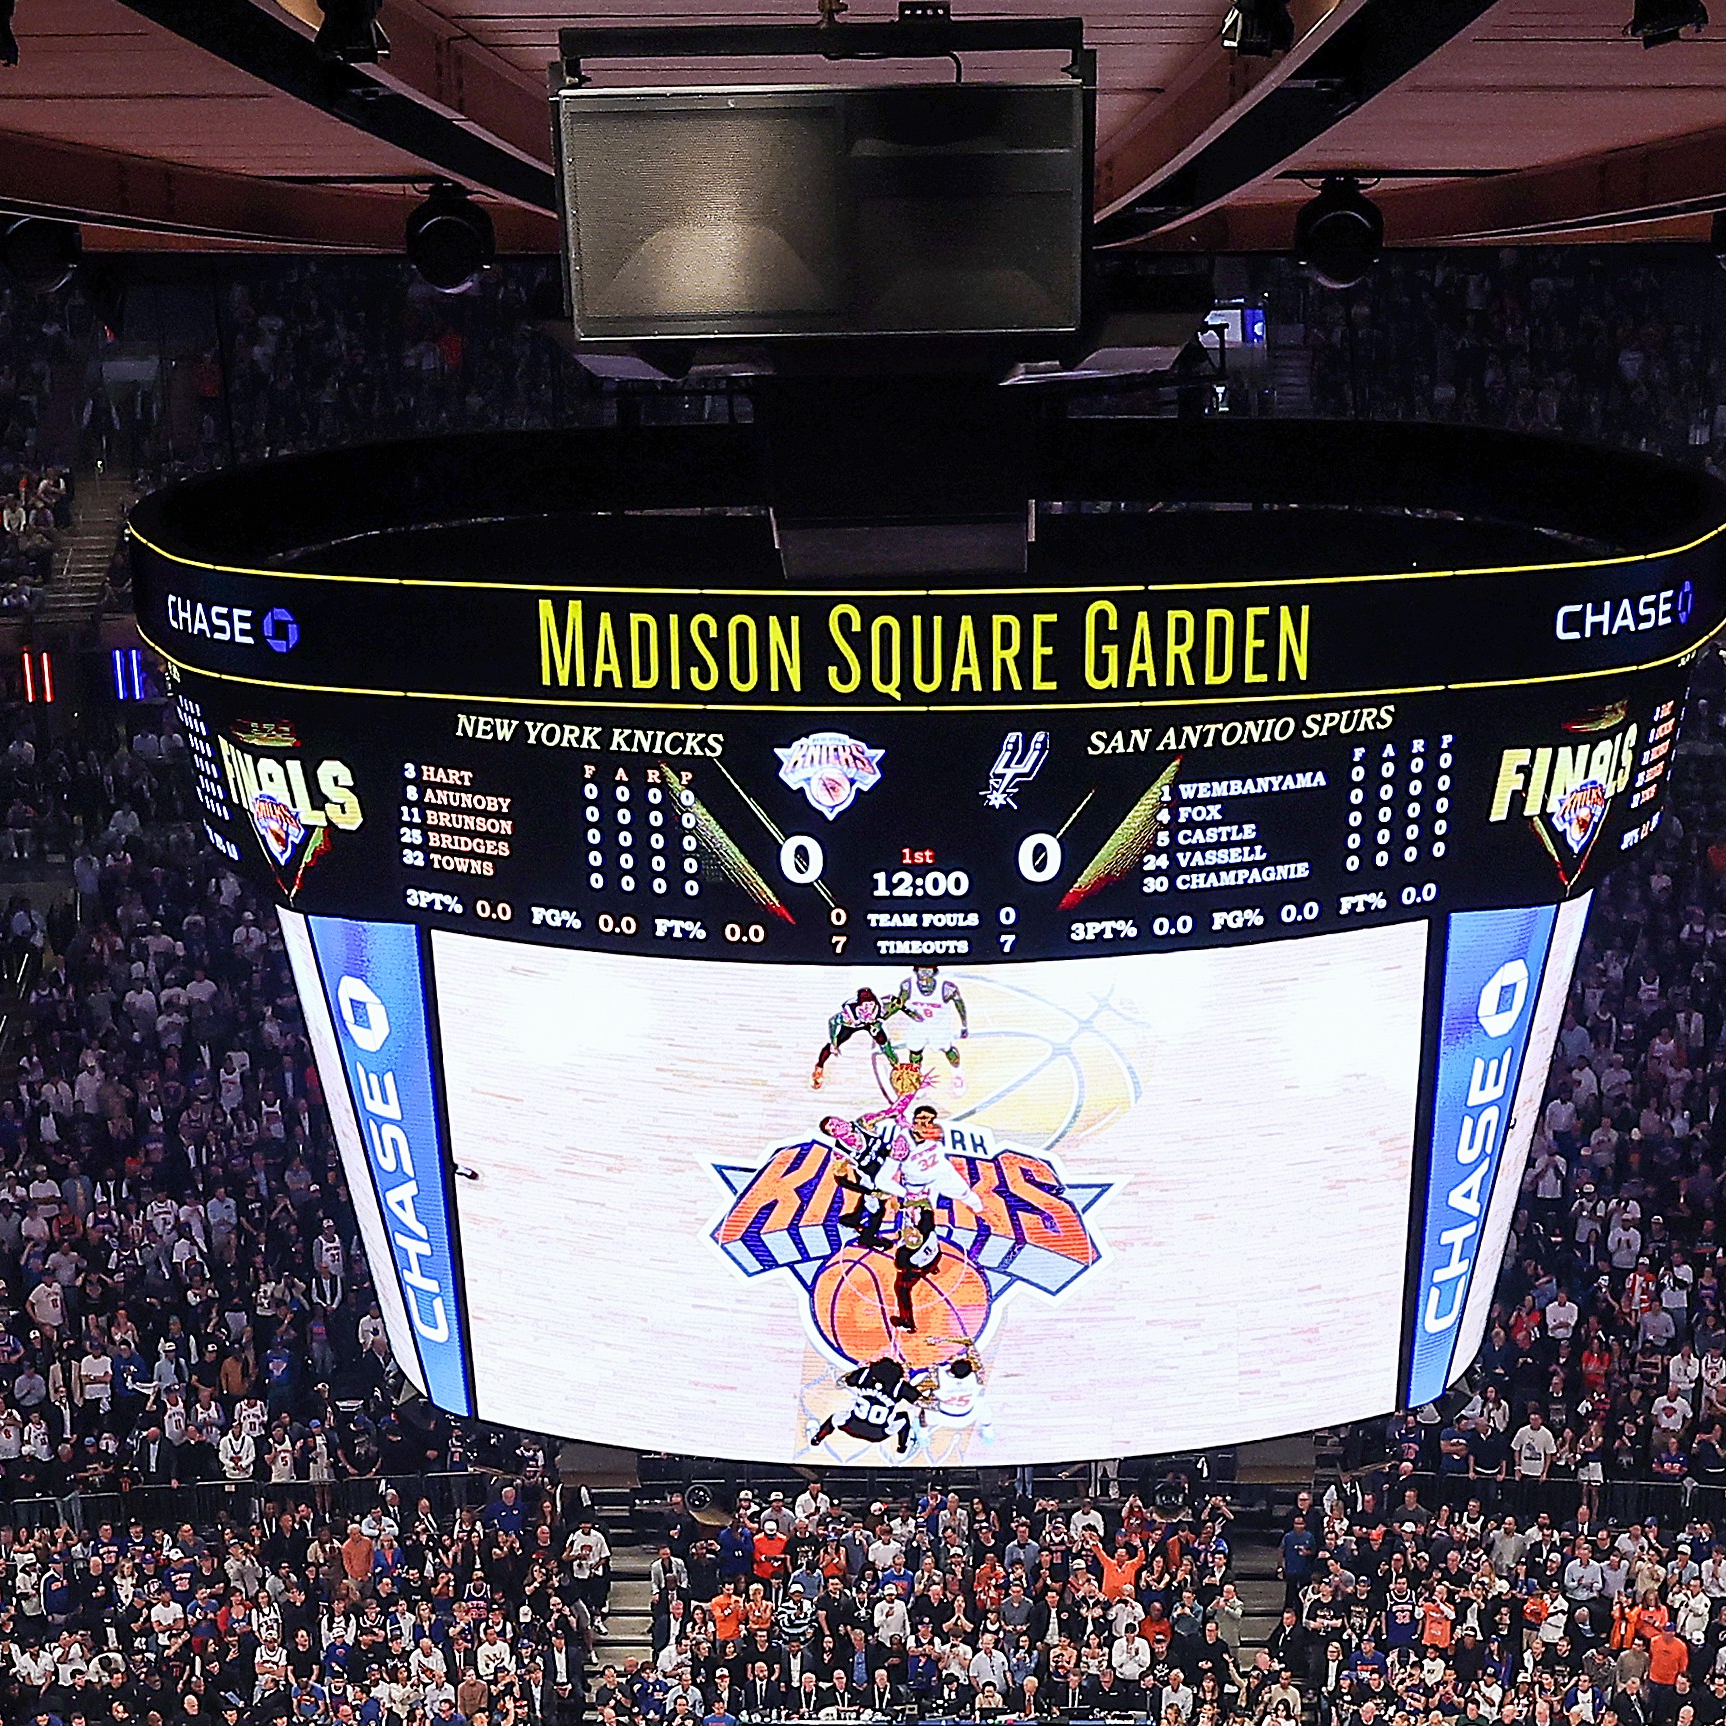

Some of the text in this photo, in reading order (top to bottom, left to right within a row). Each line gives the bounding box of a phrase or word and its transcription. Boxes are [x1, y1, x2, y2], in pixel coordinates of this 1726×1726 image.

[168, 594, 255, 646] CHASE
[1557, 589, 1674, 641] CHASE
[539, 599, 1311, 700] MADISON SQUARE GARDEN
[456, 714, 724, 757] NEW YORK KNICKS
[1087, 705, 1394, 755] SAN ANTONIO SPURS
[1353, 734, 1453, 761] F A R P
[218, 735, 363, 830] FINALS
[404, 763, 696, 808] 3 HART 0 0 0 0
[584, 765, 692, 784] F A R P
[1161, 753, 1452, 801] 1 WEMBANYAMA 0 0 0 0
[1489, 723, 1638, 822] FINALS
[407, 785, 511, 816] 8 ANUNOBY
[1155, 804, 1222, 827] 4 FOX
[401, 806, 512, 837] 11 BRUNSON
[1157, 824, 1256, 846] 5 CASTLE
[400, 827, 510, 860] 25 BRIDGES
[778, 833, 824, 886] 0
[902, 848, 934, 863] 1st
[1019, 831, 1063, 882] 0
[1143, 845, 1267, 870] 24 VASSELL
[403, 849, 493, 876] 32 TOWNS
[1143, 859, 1309, 893] 30 CHAMPAGNIE
[873, 871, 969, 896] 12:00
[407, 889, 764, 942] 3PT% 0.0 FG% 0.0 FT% 0.0
[831, 908, 846, 925] 0
[867, 913, 979, 927] TEAM FOULS
[1000, 907, 1015, 925] 0
[1071, 883, 1436, 940] 3PT% 0.0 FG% 0.0 FT% 0.0
[832, 936, 847, 953] 7
[877, 940, 968, 954] TIMEOUTS
[1000, 935, 1015, 952] 7
[355, 1061, 448, 1341] CHASE
[1423, 1047, 1512, 1333] CHASE
[854, 1395, 889, 1425] 30
